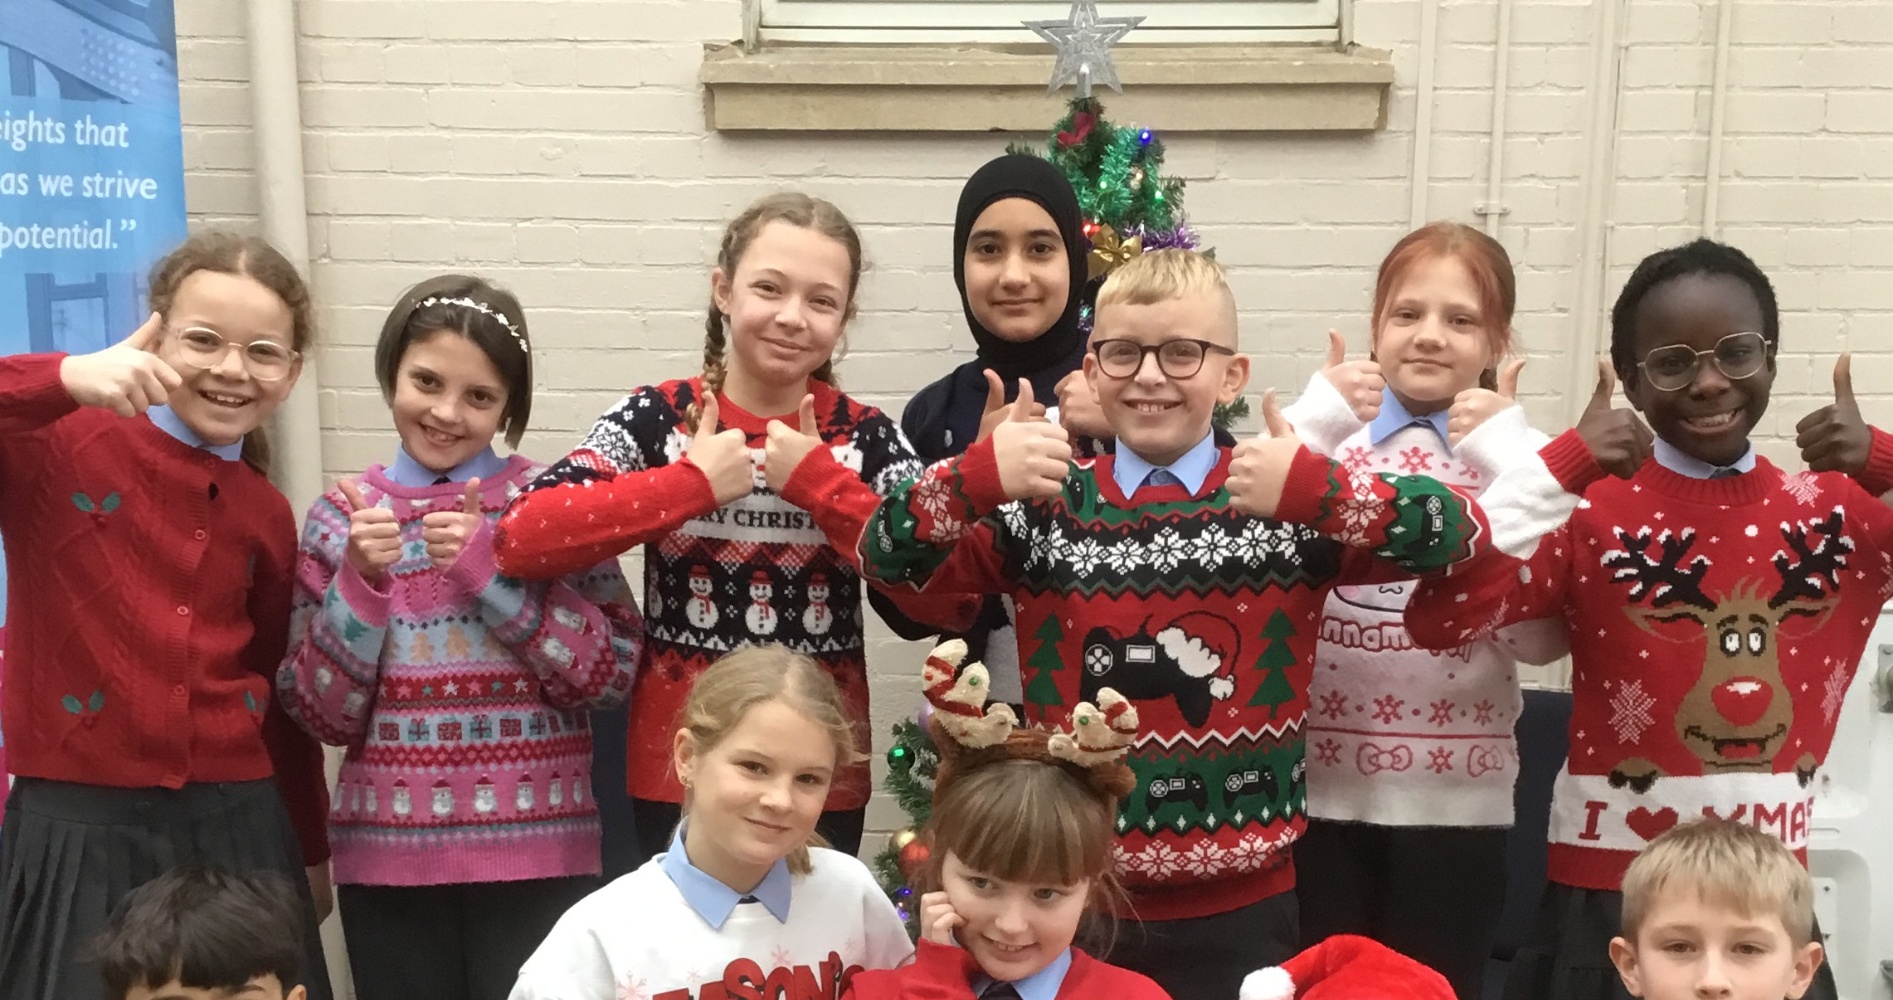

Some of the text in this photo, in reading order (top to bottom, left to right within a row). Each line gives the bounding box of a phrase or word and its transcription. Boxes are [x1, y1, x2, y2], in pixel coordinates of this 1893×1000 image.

[0, 110, 130, 152] ights that
[0, 170, 158, 200] as we strive
[733, 508, 822, 531] CHRIST
[1578, 800, 1608, 841] I
